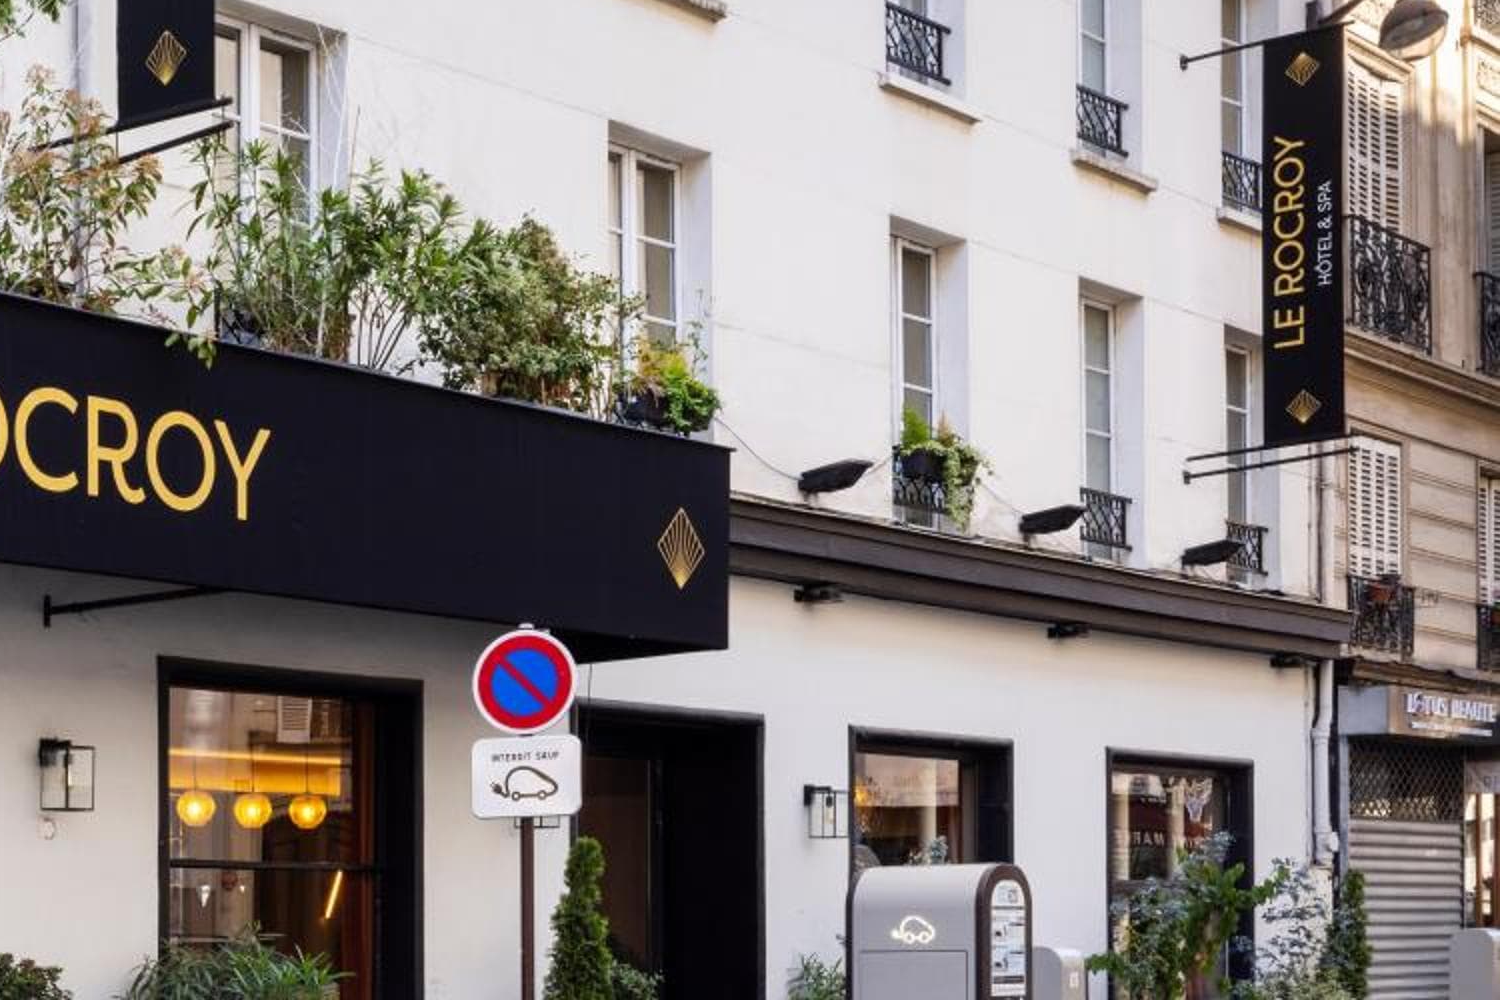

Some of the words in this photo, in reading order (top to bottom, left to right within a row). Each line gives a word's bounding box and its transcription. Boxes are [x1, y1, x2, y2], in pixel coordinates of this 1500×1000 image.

[1317, 180, 1333, 212] SPA
[1273, 135, 1305, 297] ROCROY
[1317, 215, 1333, 230] &
[1273, 305, 1305, 349] LE
